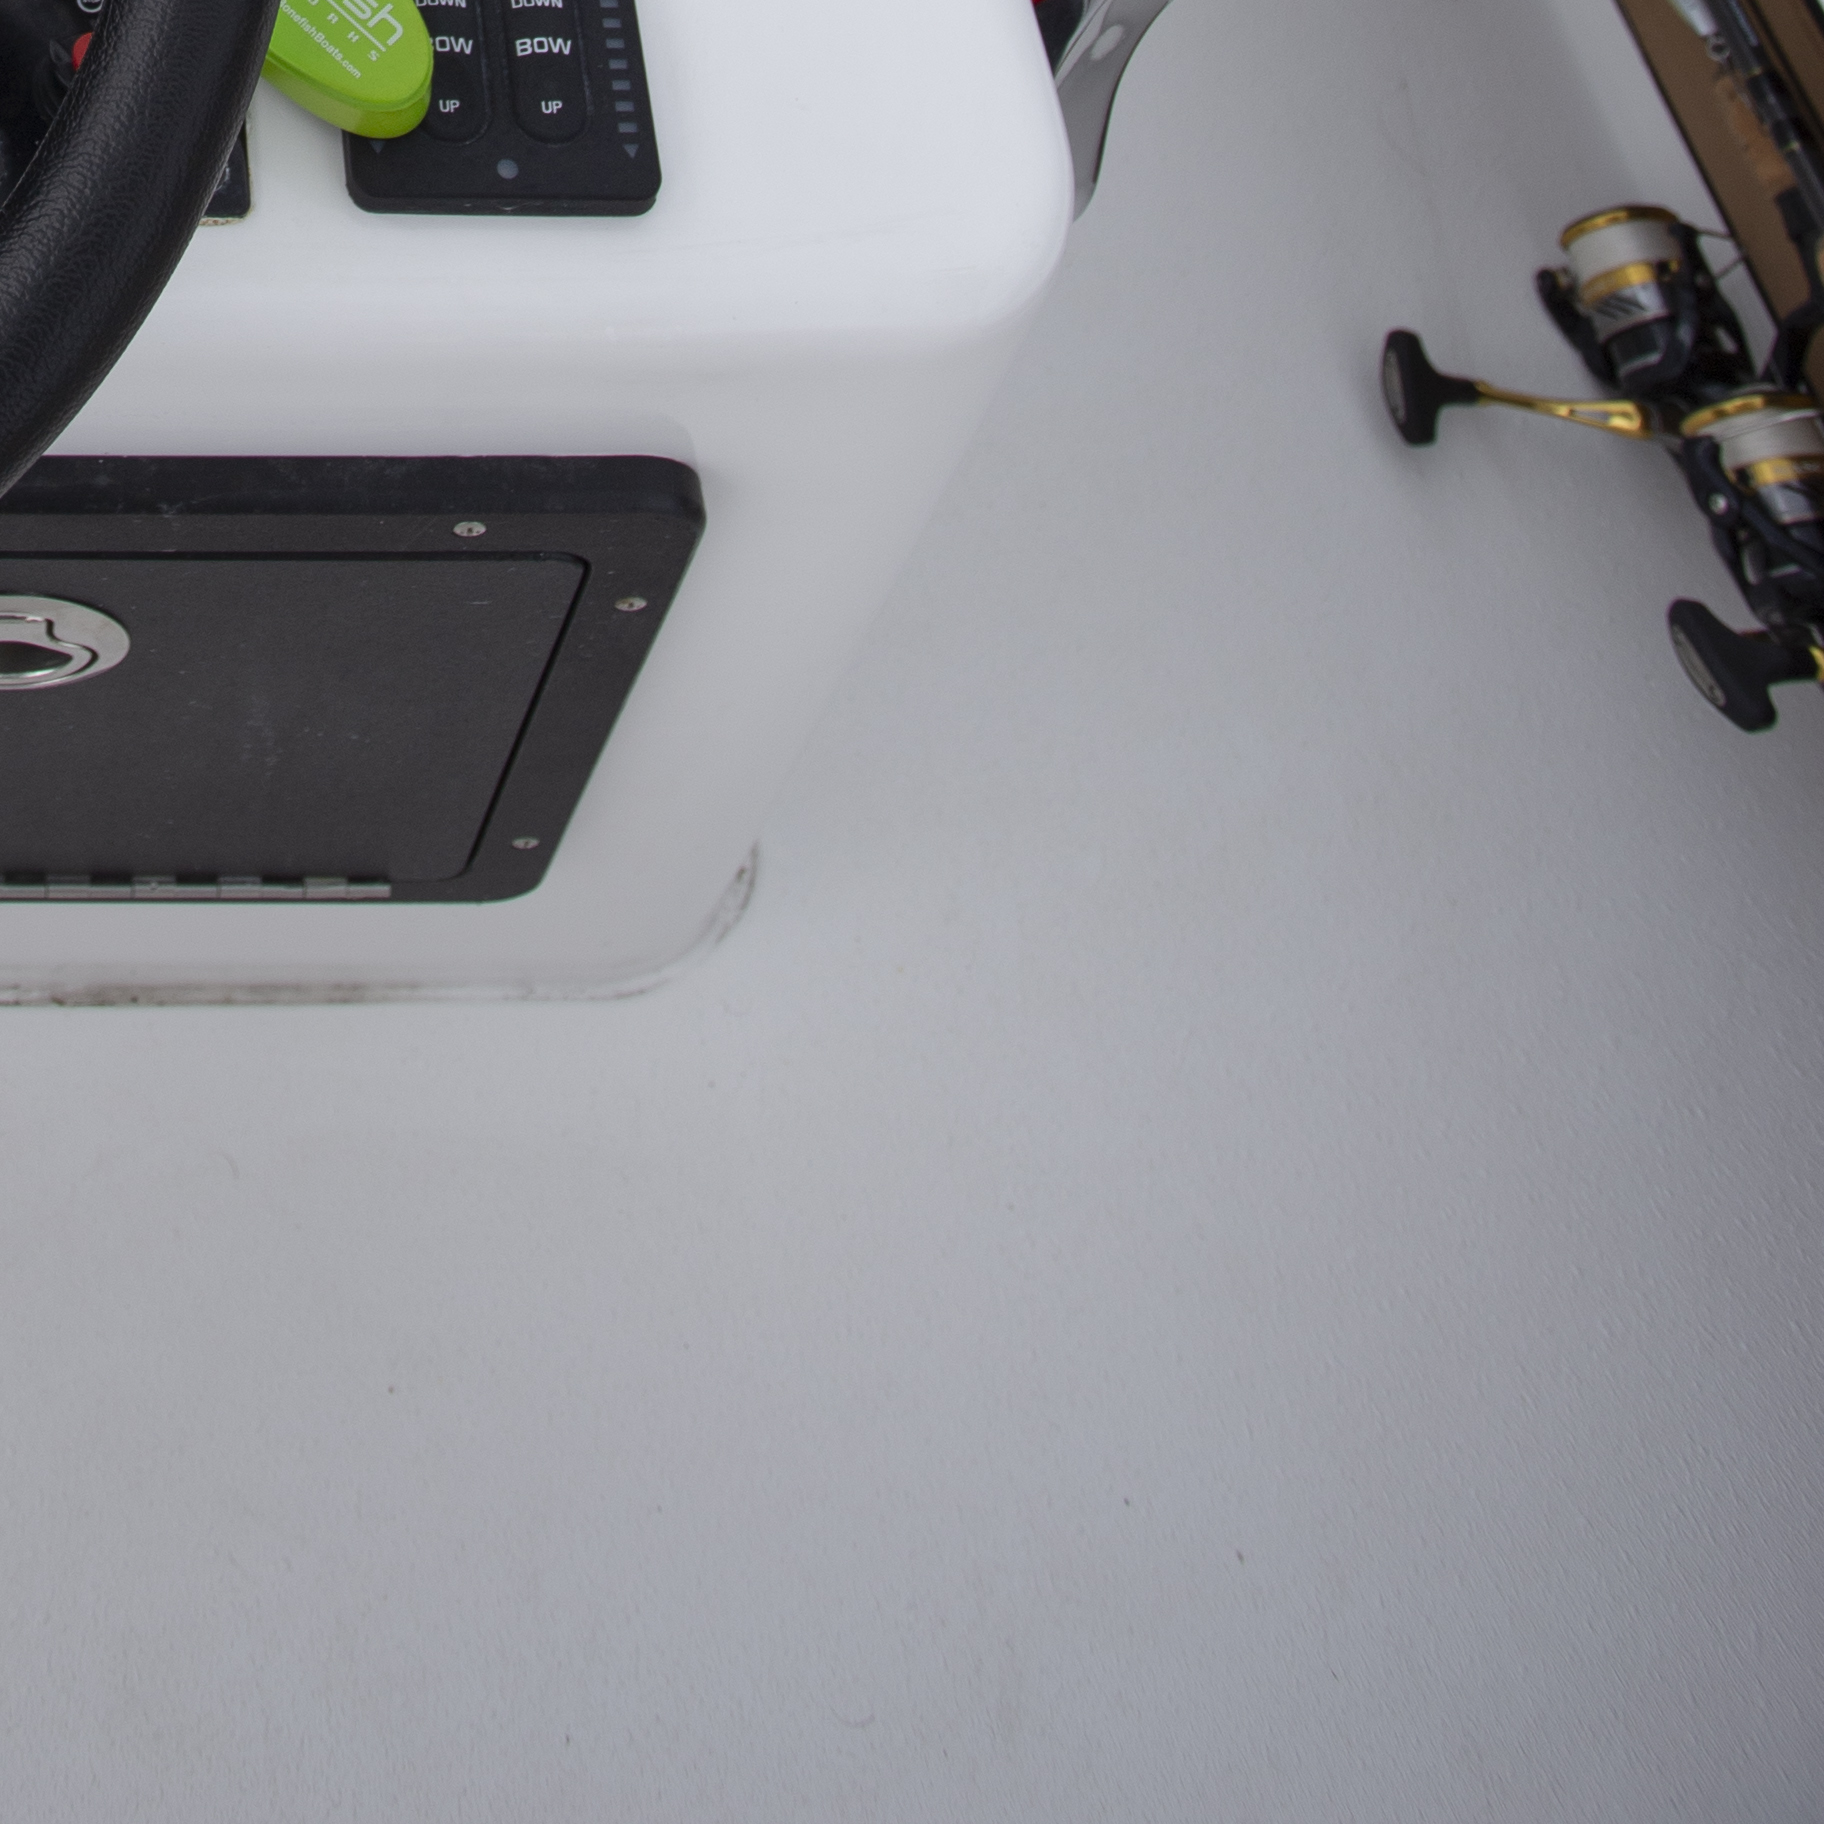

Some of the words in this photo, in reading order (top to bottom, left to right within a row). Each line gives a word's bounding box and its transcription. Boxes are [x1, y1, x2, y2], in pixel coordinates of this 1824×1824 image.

[431, 35, 474, 56] OW
[515, 37, 573, 58] BOW
[438, 99, 461, 114] UP
[541, 100, 564, 115] UP
